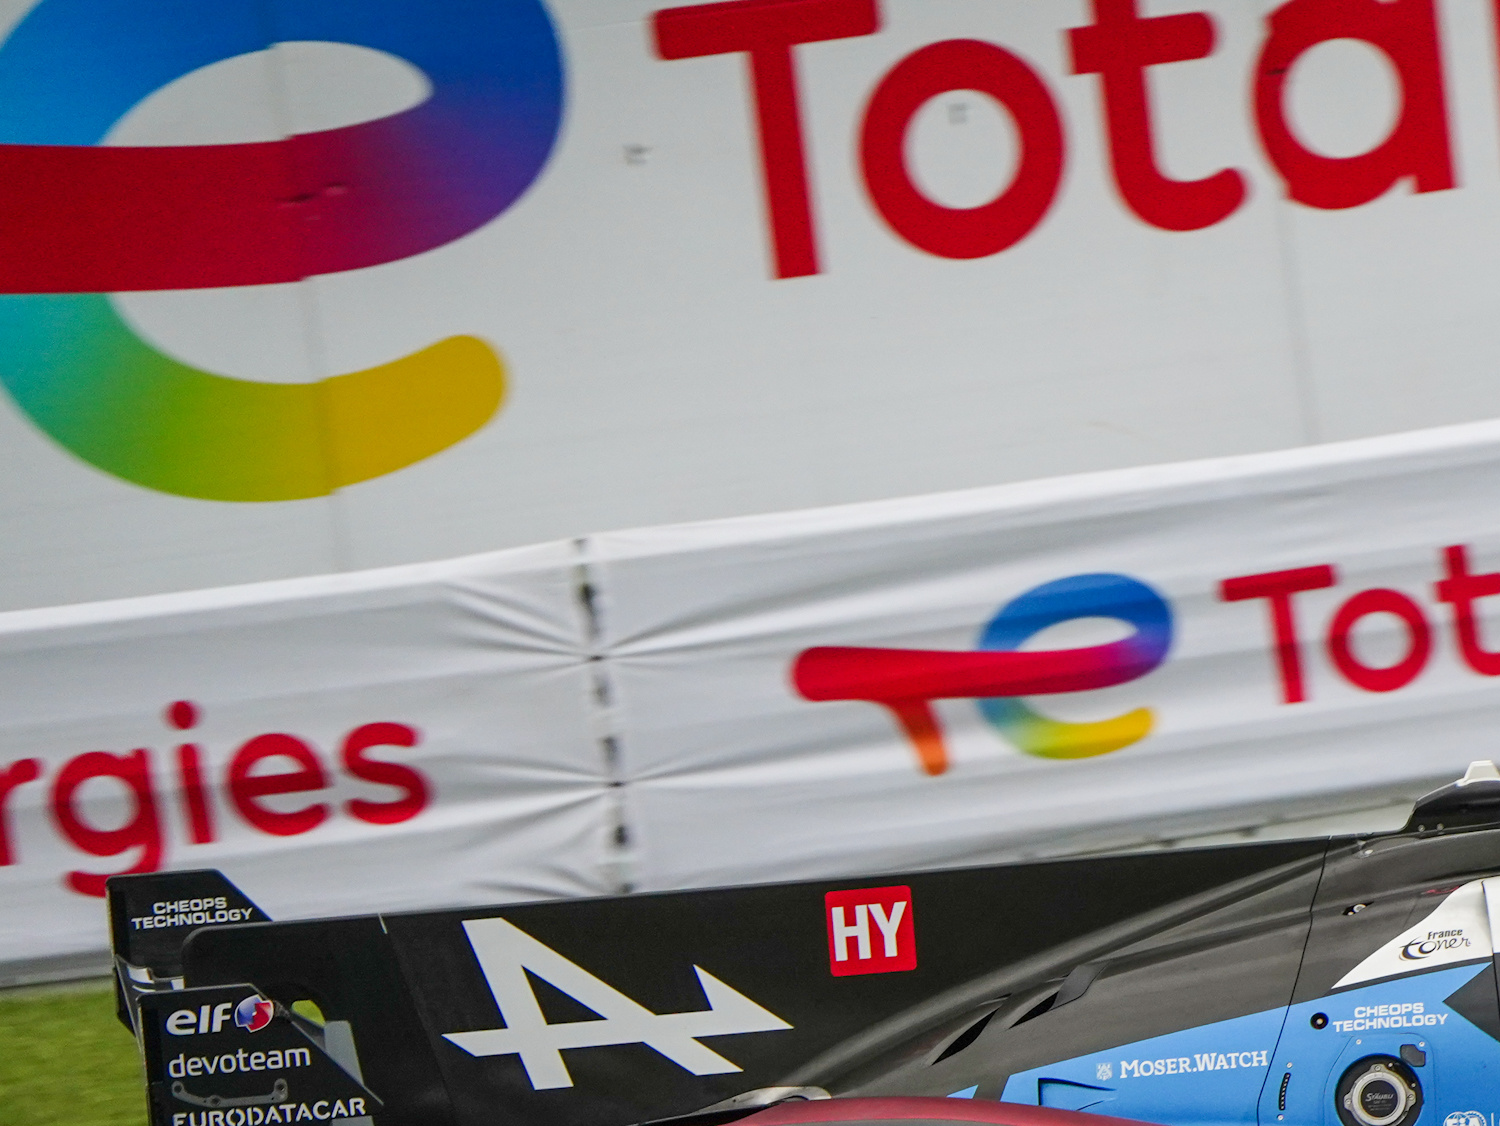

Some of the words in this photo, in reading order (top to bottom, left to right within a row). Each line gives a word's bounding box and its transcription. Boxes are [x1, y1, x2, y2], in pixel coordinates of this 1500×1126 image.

[152, 896, 228, 915] CHEOPS
[131, 907, 253, 931] TECHNOLOGY
[830, 900, 908, 962] HY
[1426, 927, 1464, 941] France
[165, 1002, 233, 1036] elf
[1353, 1002, 1425, 1018] CHEOPS
[1332, 1013, 1449, 1033] TECHNOLOGY
[168, 1047, 312, 1079] devoteam
